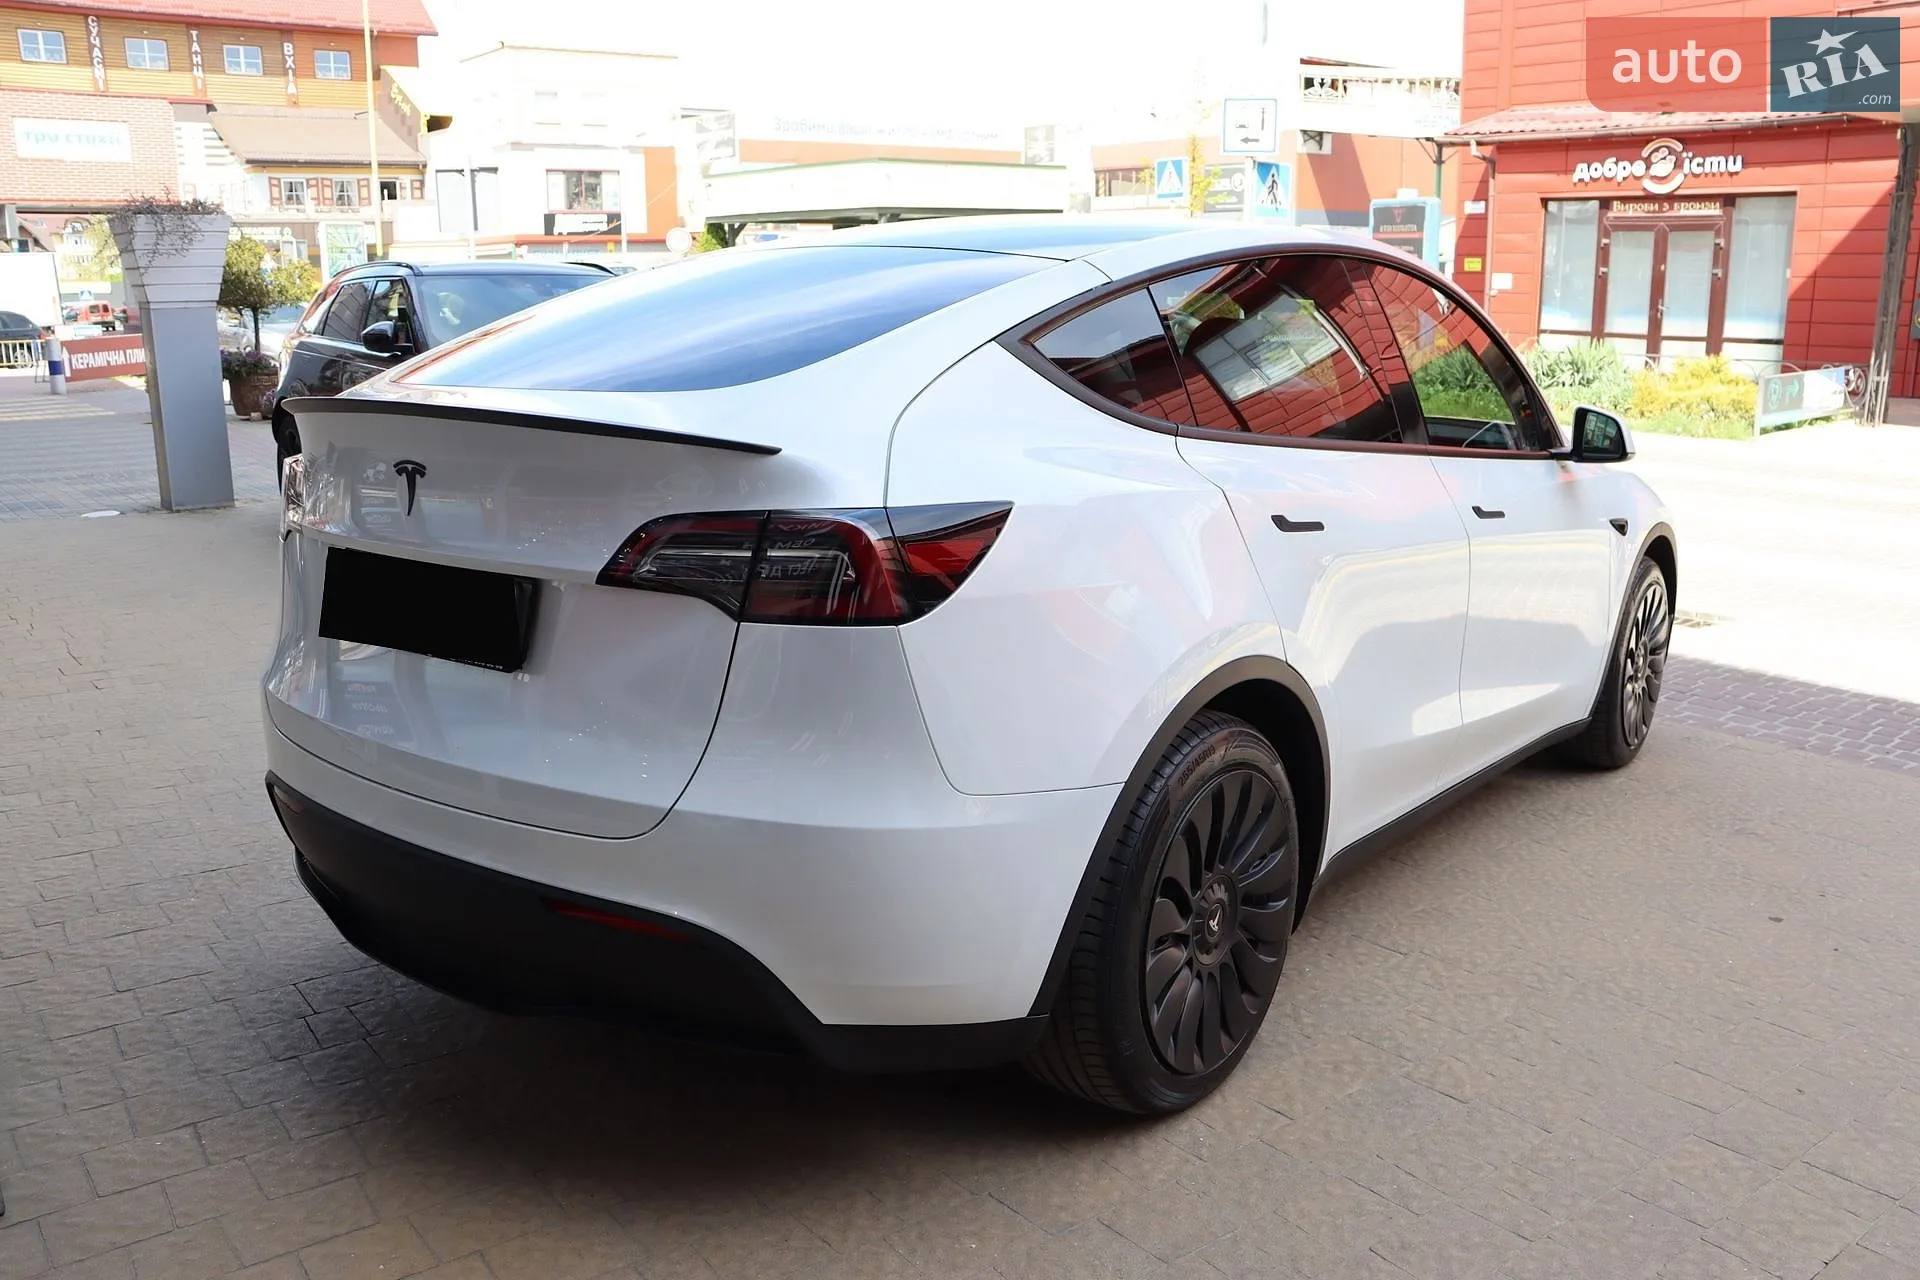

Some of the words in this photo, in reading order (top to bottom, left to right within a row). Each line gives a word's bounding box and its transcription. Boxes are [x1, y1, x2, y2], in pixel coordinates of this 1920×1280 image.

[87, 15, 106, 92] СУЧАСНІ
[189, 30, 204, 91] ТАНЦІ
[283, 42, 298, 96] ВХІД
[1682, 151, 1743, 175] їсти
[70, 349, 126, 370] КЕРАМІЧНА
[125, 347, 146, 364] ПЛИ
